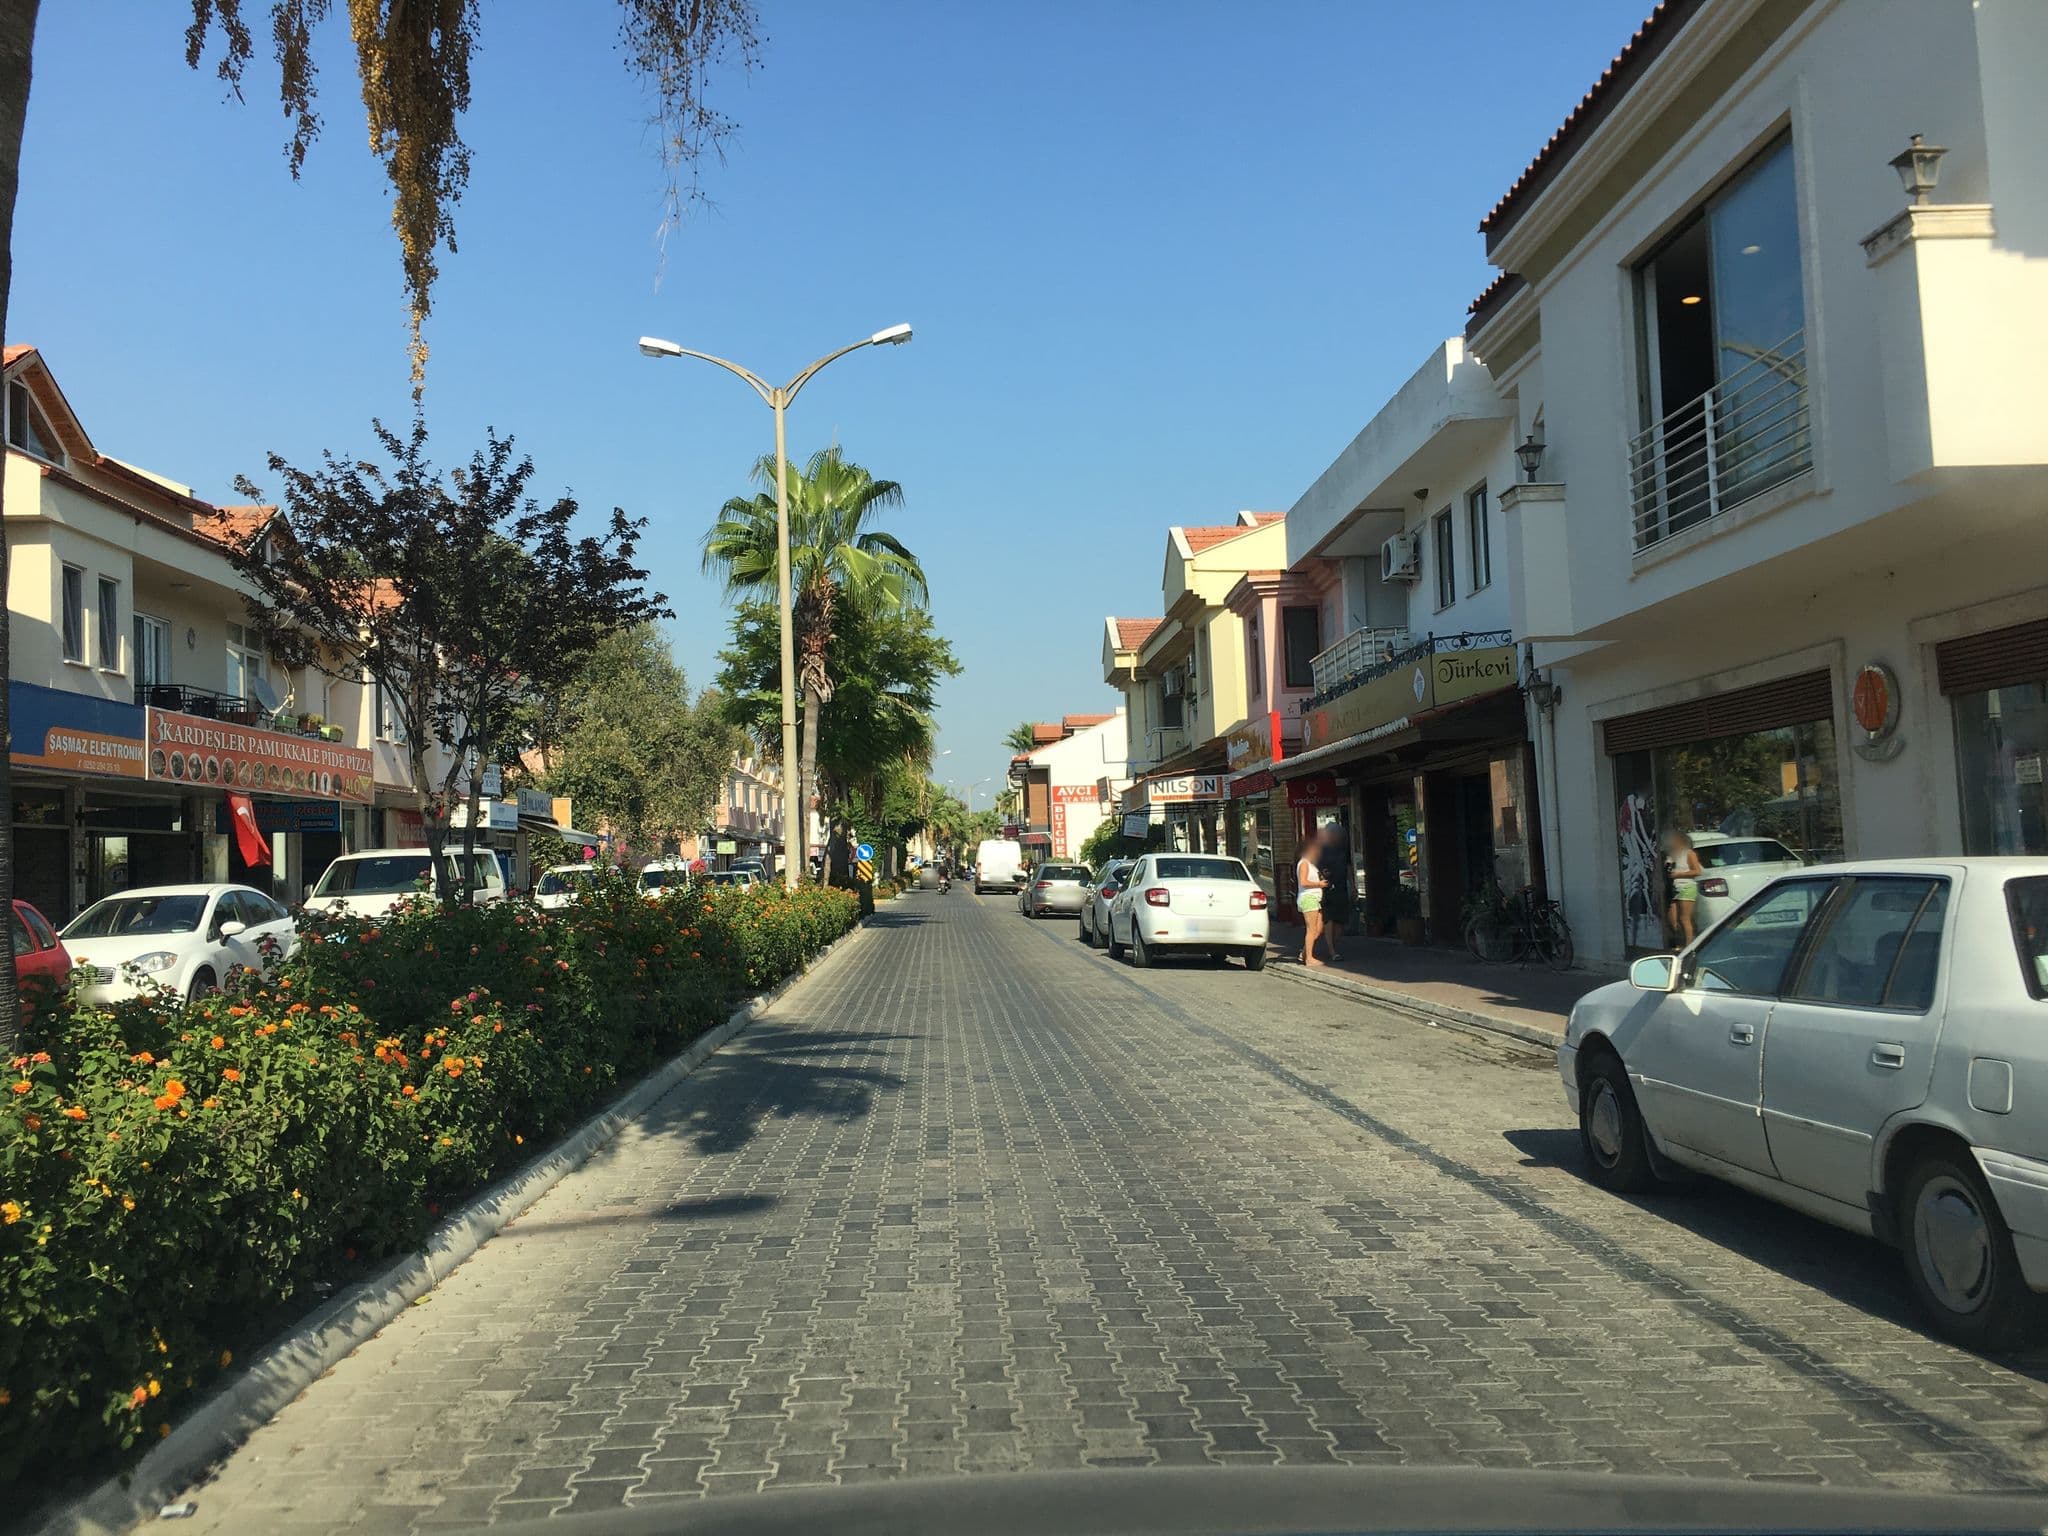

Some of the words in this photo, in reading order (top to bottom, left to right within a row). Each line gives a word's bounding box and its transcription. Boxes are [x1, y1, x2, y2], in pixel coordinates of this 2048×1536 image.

[1438, 655, 1510, 684] Türkevi
[49, 734, 88, 756] ŞAŞMAZ
[89, 740, 144, 761] ELEKTRONİK
[163, 722, 247, 754] KARDEŞLER
[248, 736, 320, 764] PAMUKKALE
[321, 748, 346, 769] PİDE
[346, 753, 374, 774] PİZZA
[1056, 786, 1091, 796] AVCI
[1153, 779, 1216, 794] NILSON
